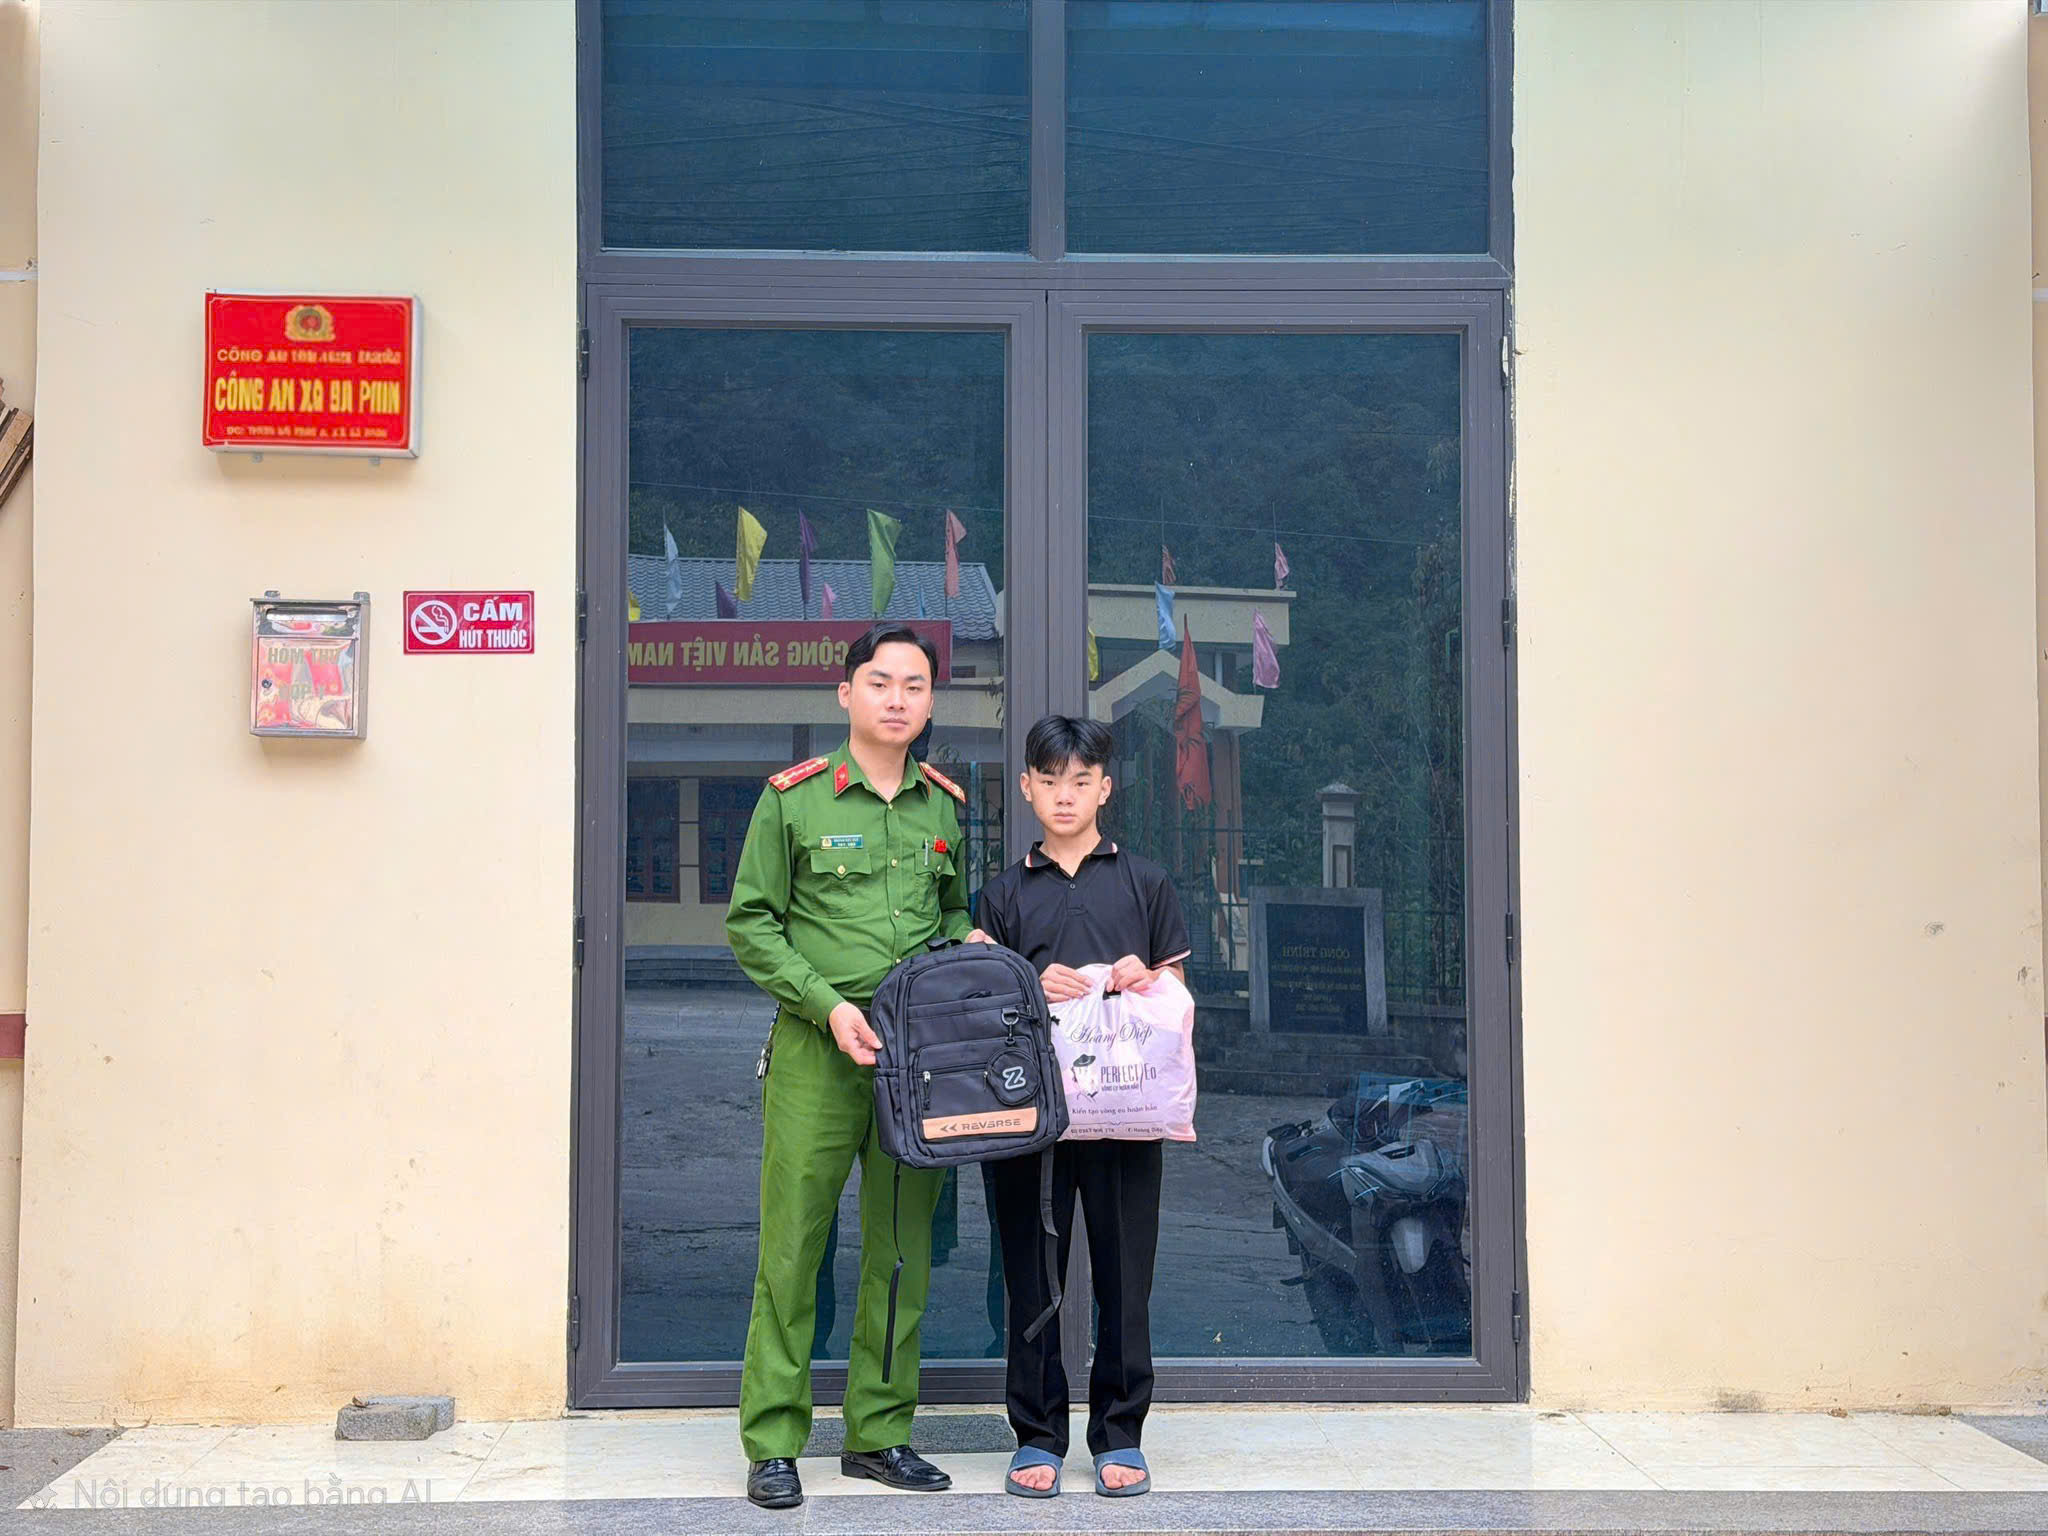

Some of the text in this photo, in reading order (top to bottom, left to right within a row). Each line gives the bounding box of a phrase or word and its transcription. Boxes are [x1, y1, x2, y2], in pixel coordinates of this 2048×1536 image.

[214, 370, 264, 412] CÔNG
[463, 596, 523, 621] CẤM
[459, 624, 528, 649] HÚT THUỐC
[962, 1118, 1021, 1131] REVERSE
